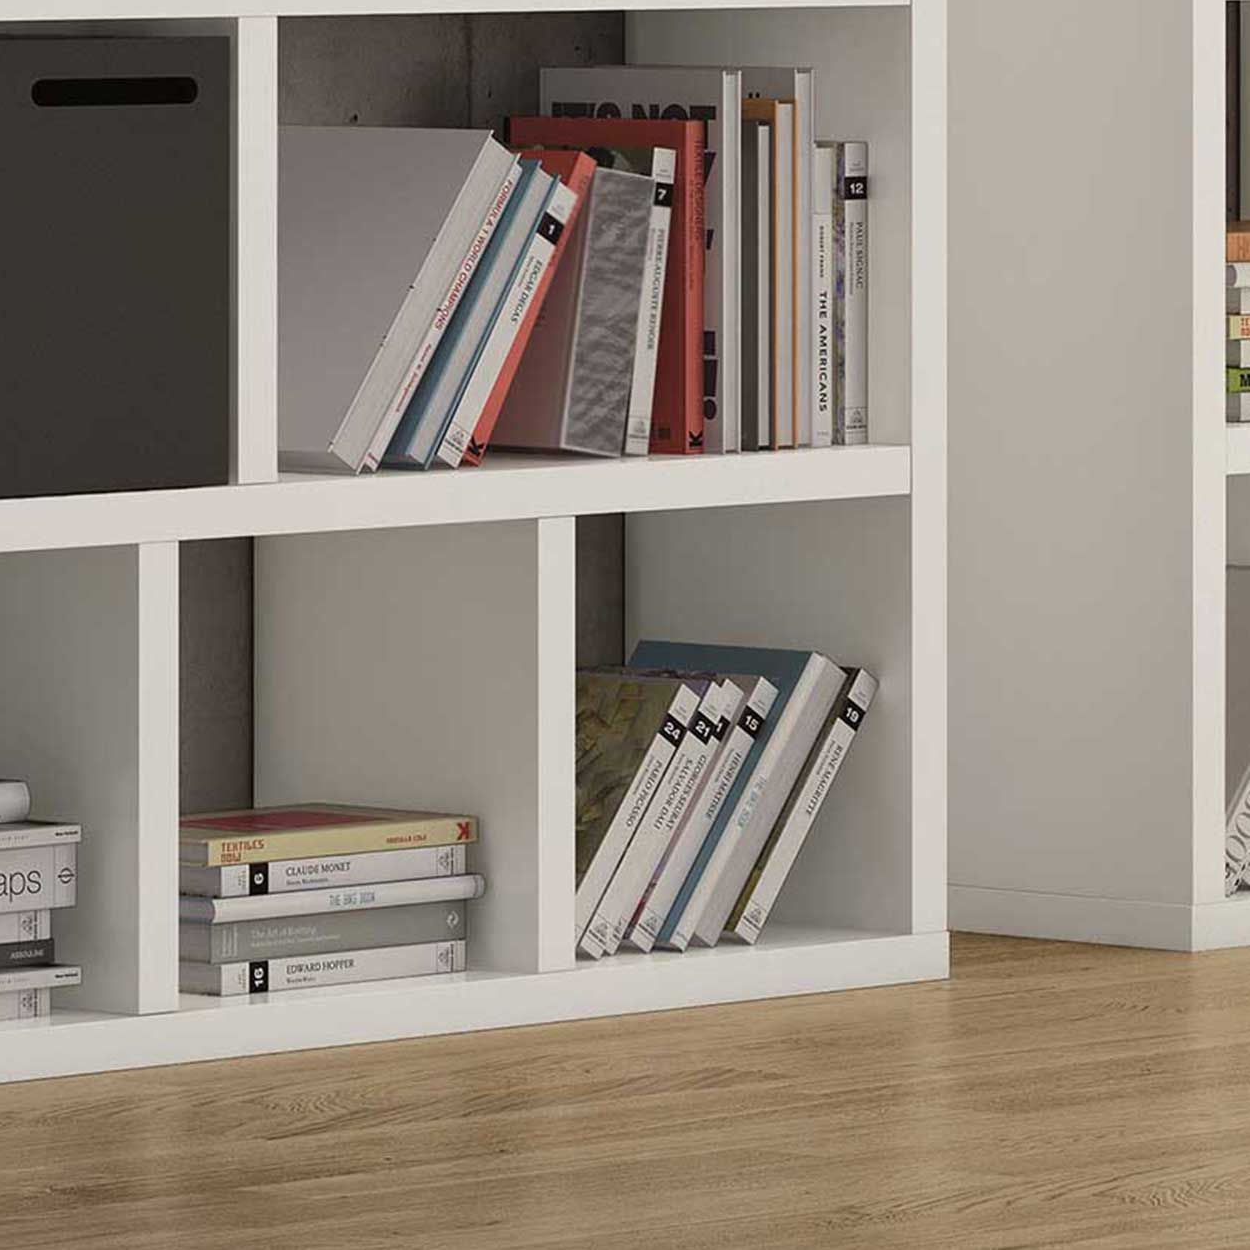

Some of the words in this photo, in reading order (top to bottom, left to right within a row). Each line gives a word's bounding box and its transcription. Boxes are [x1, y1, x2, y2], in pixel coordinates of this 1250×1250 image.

[483, 178, 515, 228] FORMULA
[657, 188, 667, 201] 7
[849, 182, 865, 195] 12
[855, 221, 864, 247] PAUL
[461, 234, 487, 272] WORLD
[521, 259, 545, 294] EDGAR
[855, 249, 864, 289] SIGNAC
[431, 270, 469, 331] CHAMPIONS
[508, 291, 530, 324] DEGAS
[819, 291, 828, 319] THE
[819, 324, 828, 413] AMERICANS
[693, 720, 711, 737] 21
[741, 713, 760, 731] 15
[842, 706, 860, 723] 19
[661, 721, 682, 741] 24
[643, 759, 663, 789] PABLO
[683, 754, 707, 792] GEORGES
[722, 751, 741, 780] HENRI
[663, 757, 693, 807] SALVADOR
[804, 769, 832, 815] MAGRITTE
[623, 786, 649, 829] PICASSO
[663, 789, 689, 831] SEURAT
[702, 778, 729, 819] MATISSE
[221, 839, 264, 852] TEXTILES
[286, 863, 318, 877] CLAUDE
[318, 861, 350, 874] MONET
[286, 962, 321, 975] EDWARD
[321, 959, 354, 972] HOPPER
